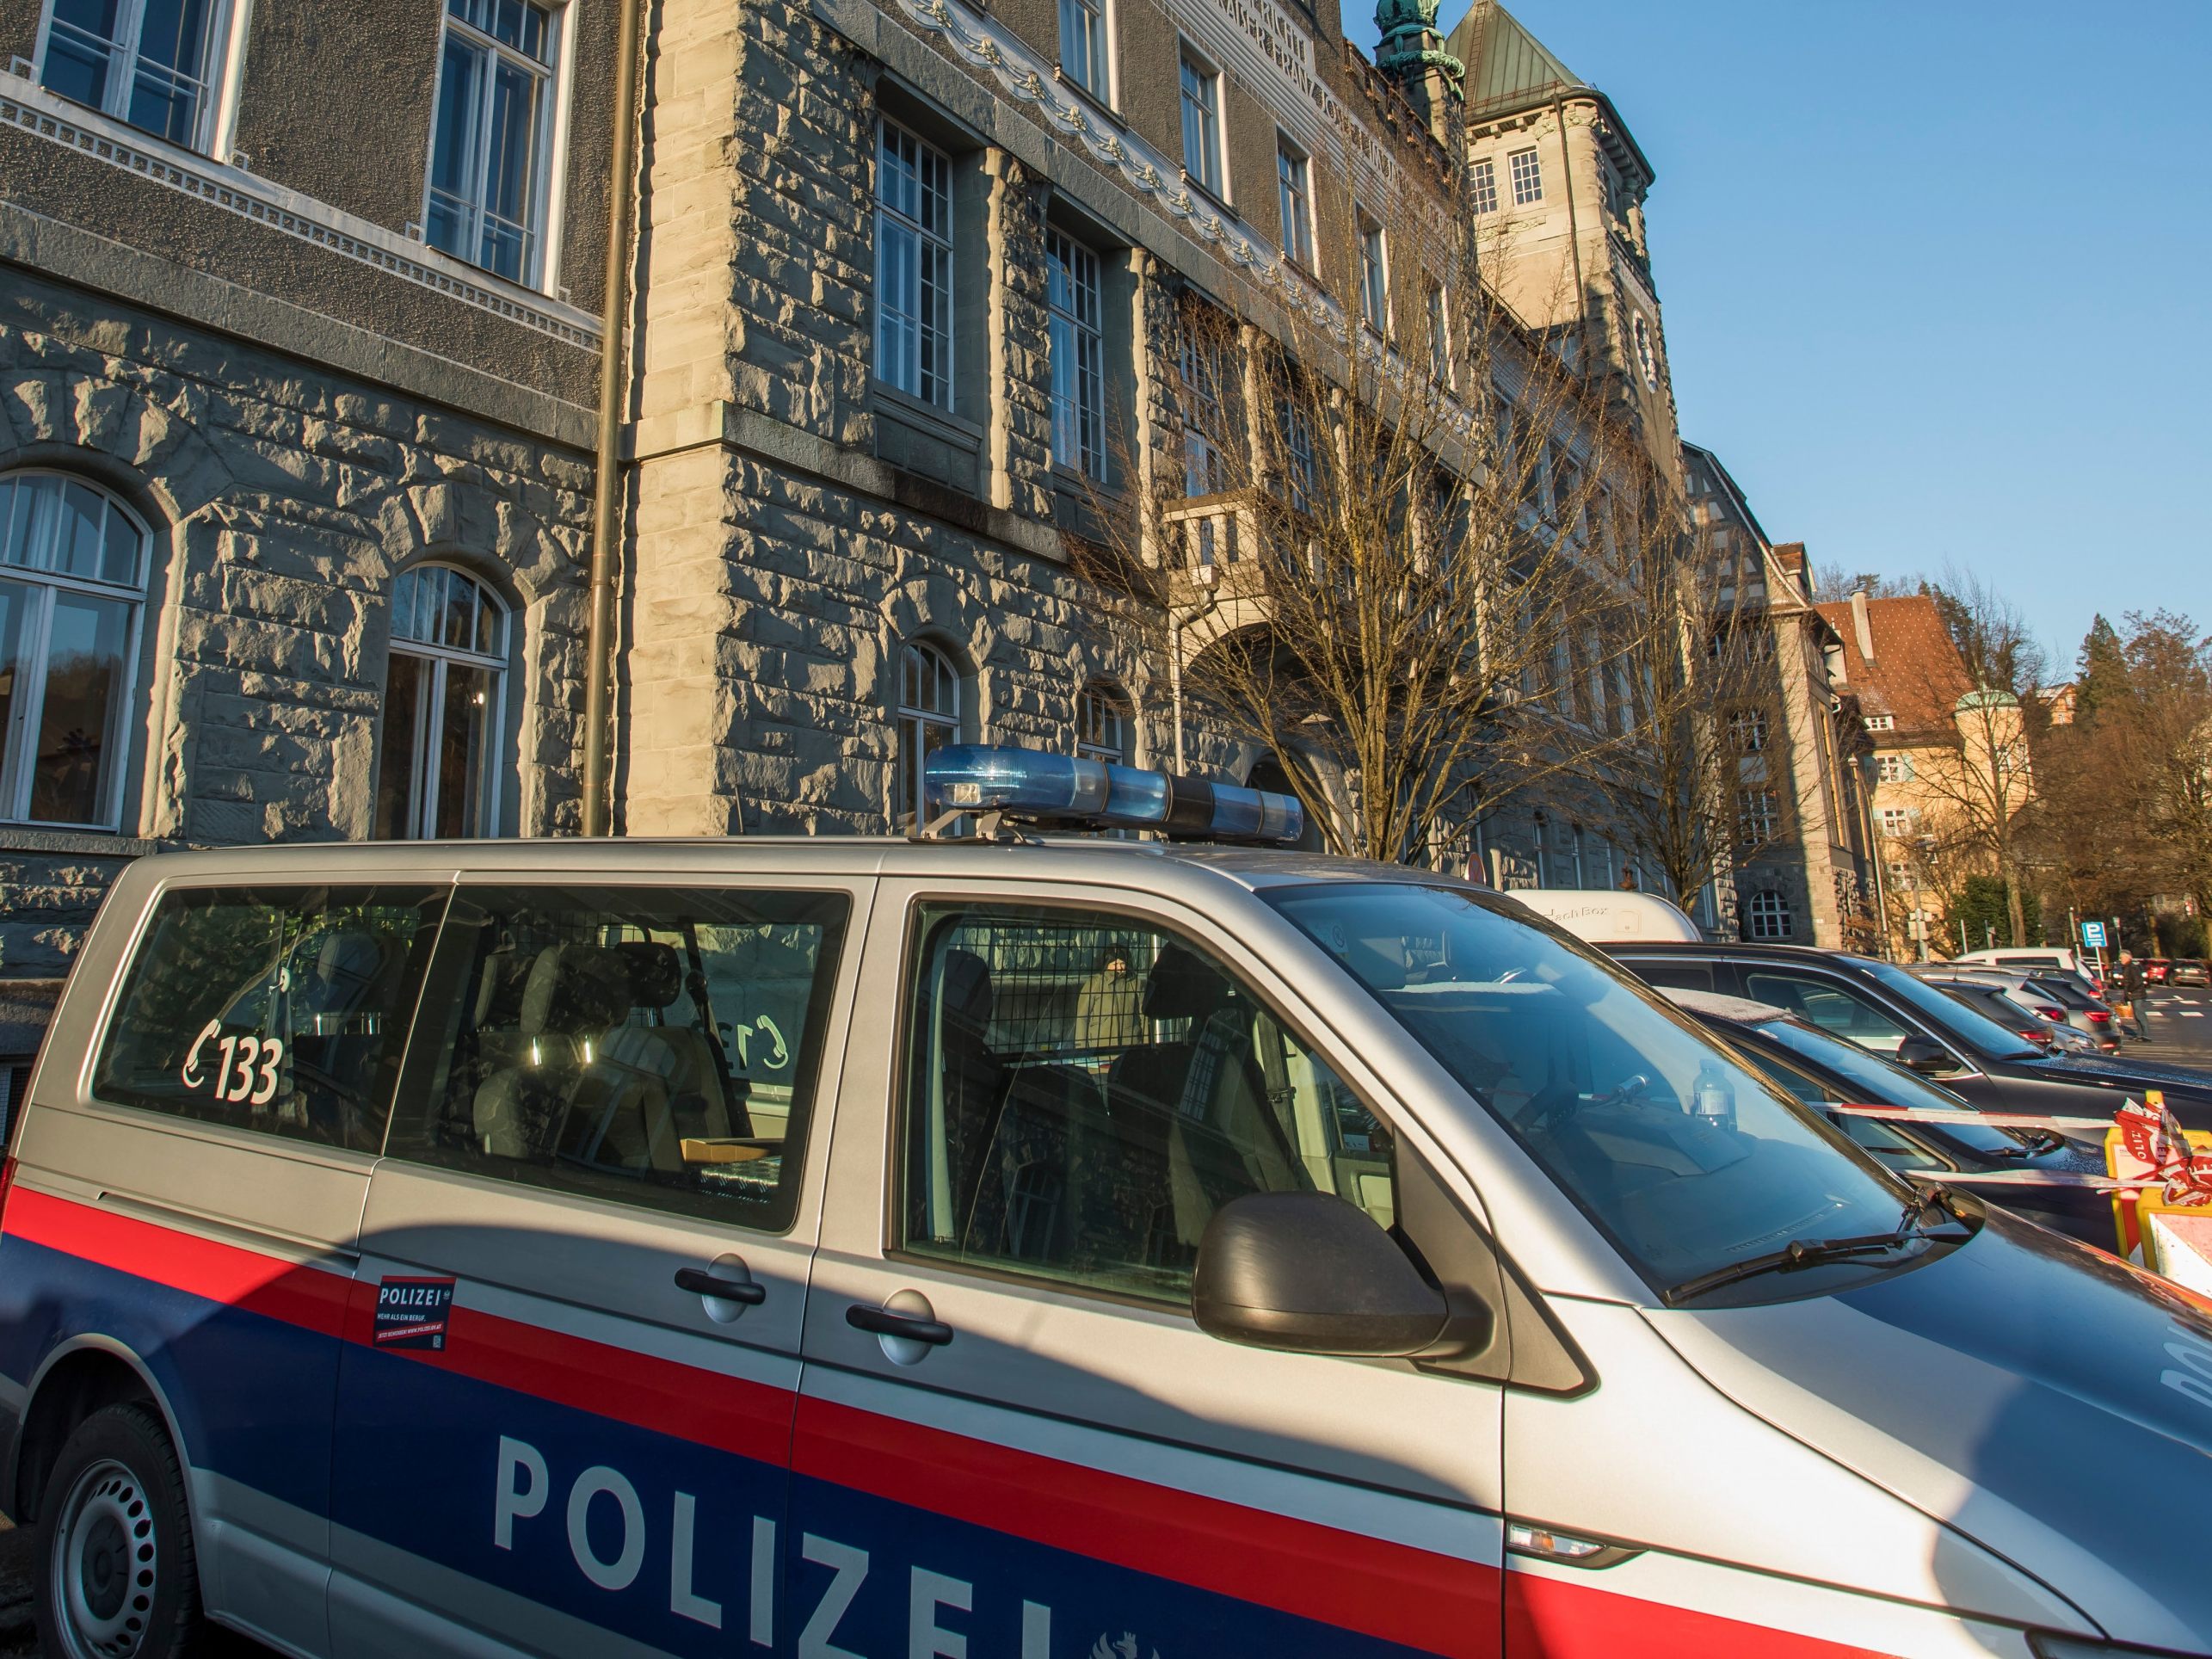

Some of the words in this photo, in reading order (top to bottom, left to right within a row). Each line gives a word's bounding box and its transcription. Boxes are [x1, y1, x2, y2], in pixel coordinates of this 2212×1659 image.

[1272, 38, 1315, 101] FRANZ
[215, 1035, 283, 1105] 133
[379, 1288, 441, 1306] POLIZEI
